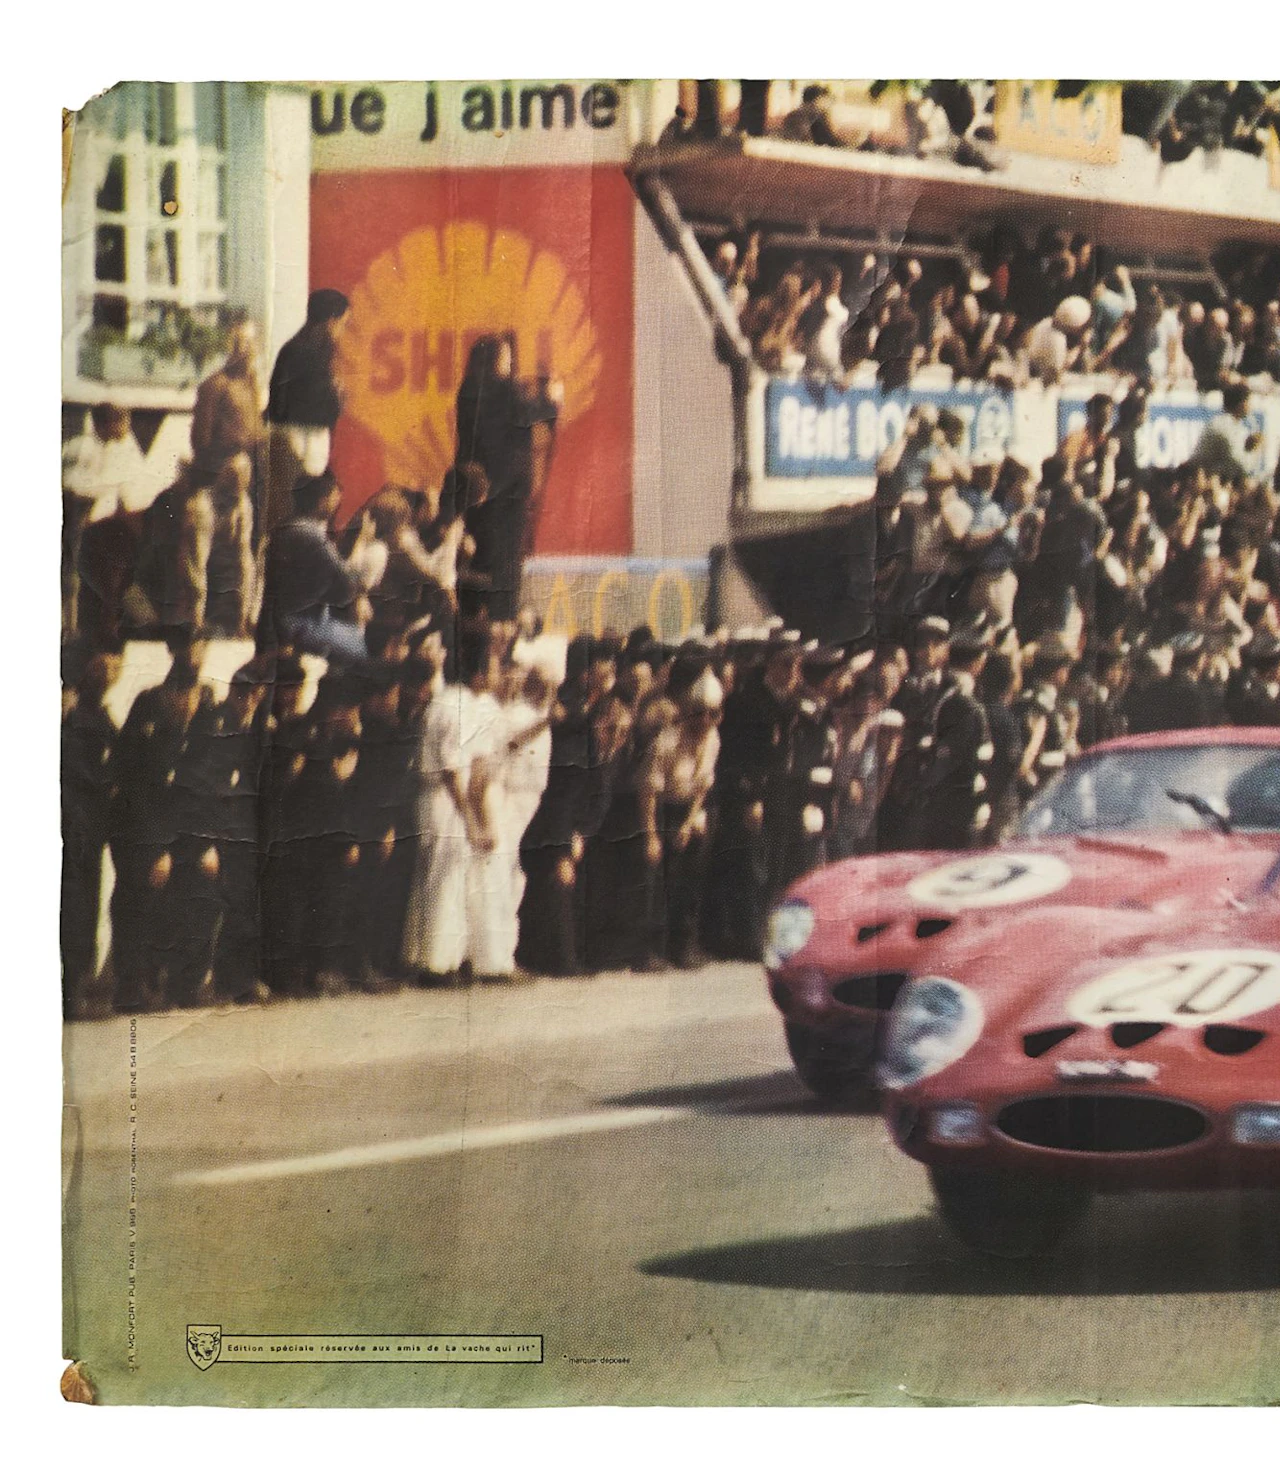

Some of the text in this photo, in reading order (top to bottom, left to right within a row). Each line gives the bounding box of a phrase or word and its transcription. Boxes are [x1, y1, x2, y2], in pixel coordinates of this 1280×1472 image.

[1092, 961, 1272, 1015] 20
[227, 1344, 264, 1352] Edition
[270, 1344, 314, 1353] spéciale
[397, 1344, 421, 1352] amis
[427, 1344, 439, 1352] de
[446, 1344, 457, 1352] La
[462, 1344, 491, 1352] vache
[495, 1344, 512, 1353] qui
